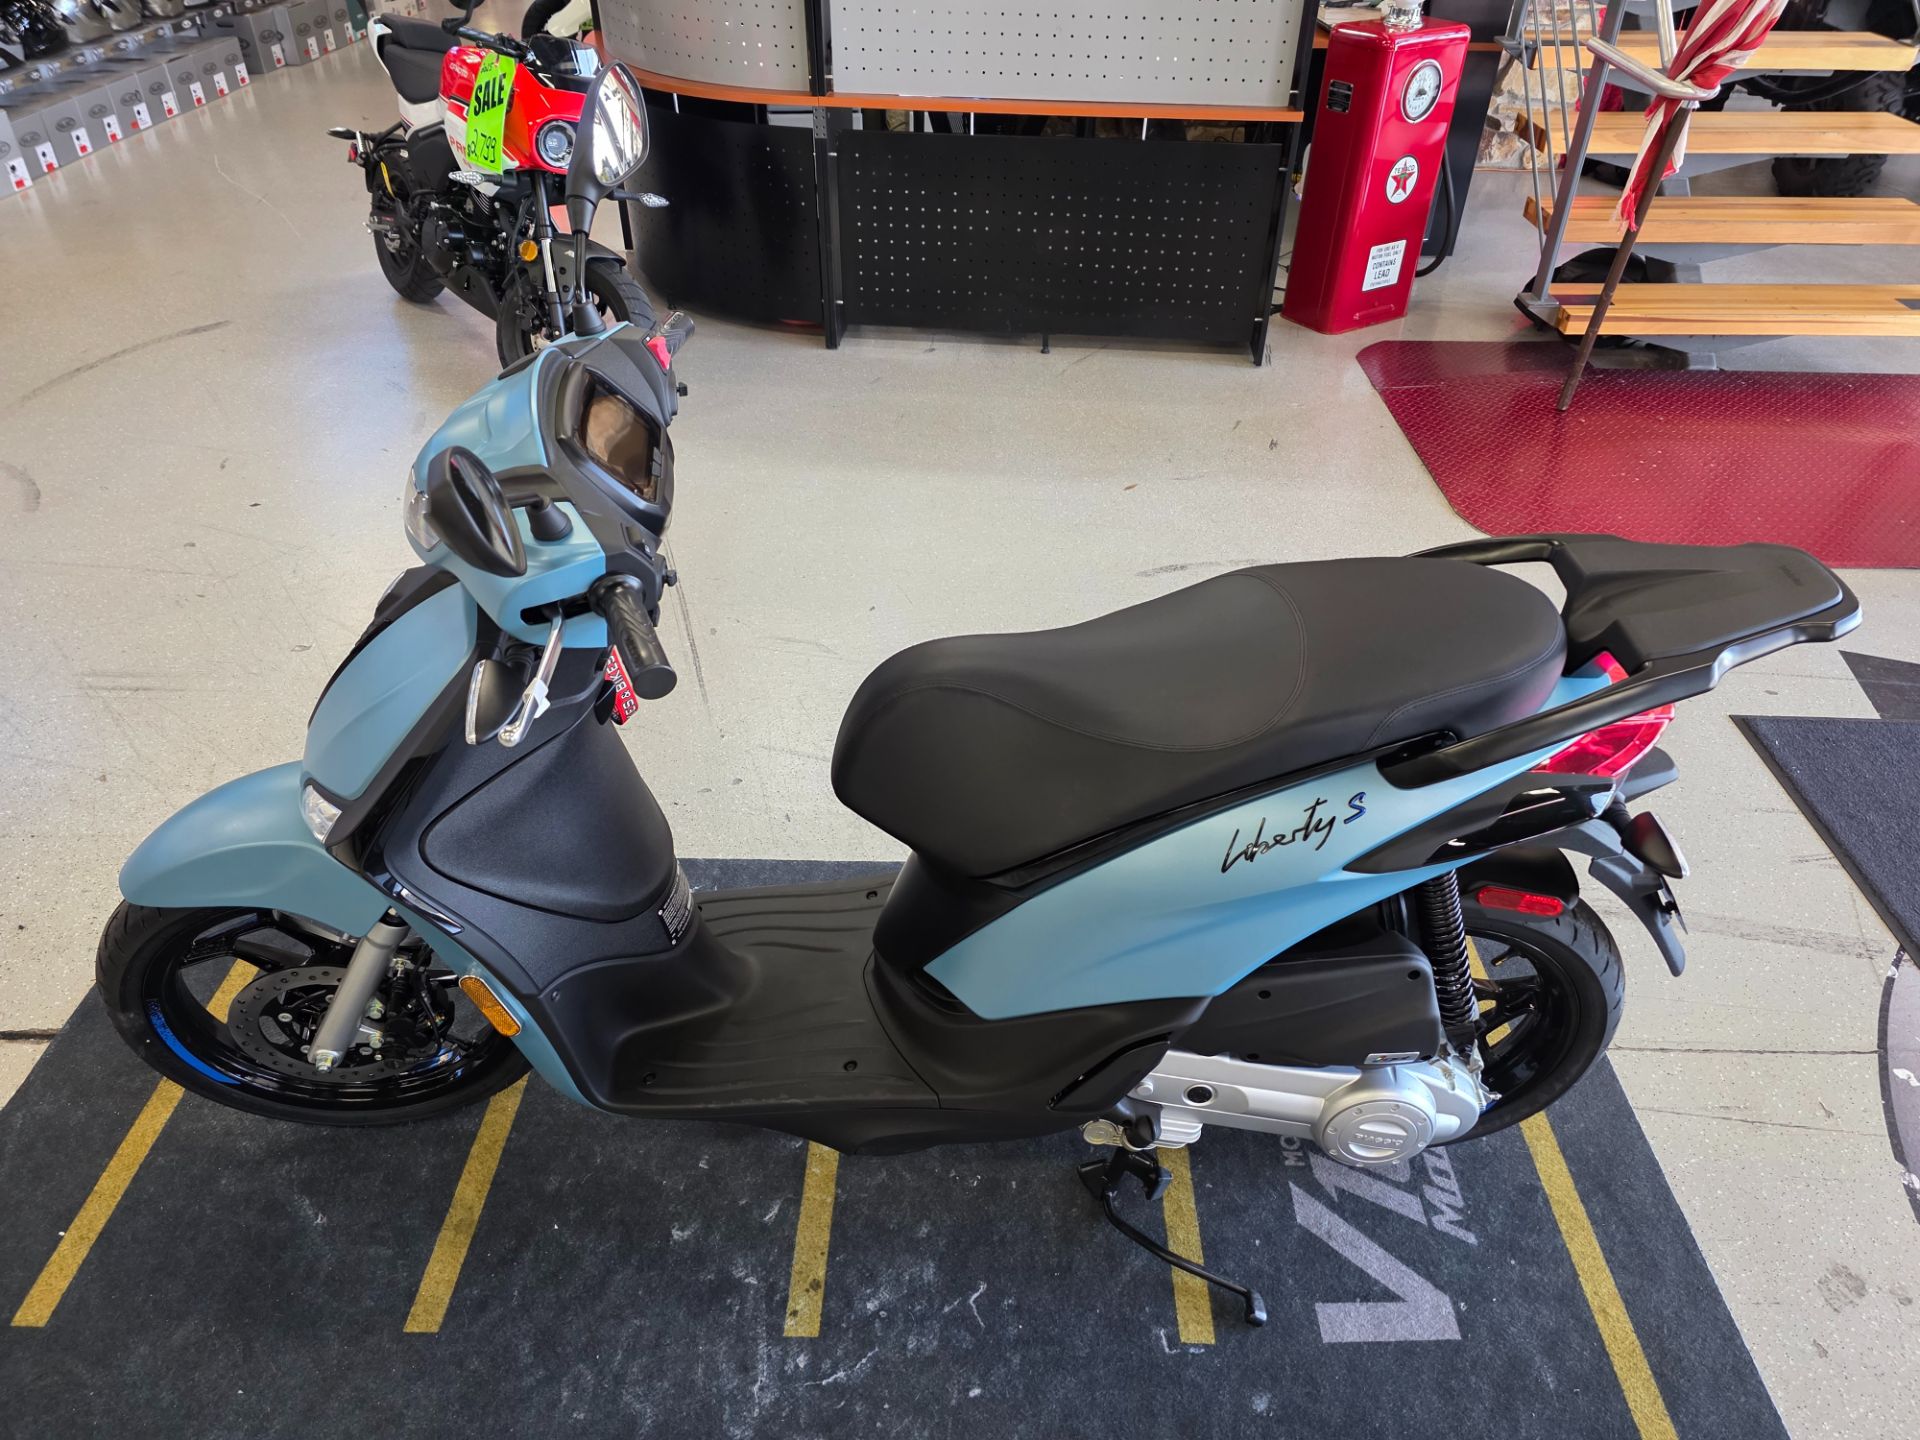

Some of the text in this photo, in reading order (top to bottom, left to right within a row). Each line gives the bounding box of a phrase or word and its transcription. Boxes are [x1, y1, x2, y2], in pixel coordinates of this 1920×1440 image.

[473, 72, 507, 117] SALE
[467, 128, 497, 164] $2,799
[1394, 164, 1416, 175] TEXACO
[1372, 258, 1397, 270] CONTAINS
[1374, 268, 1391, 280] LEAD
[606, 655, 627, 693] BIKES
[621, 690, 631, 699] &
[1221, 791, 1367, 874] Liberty S
